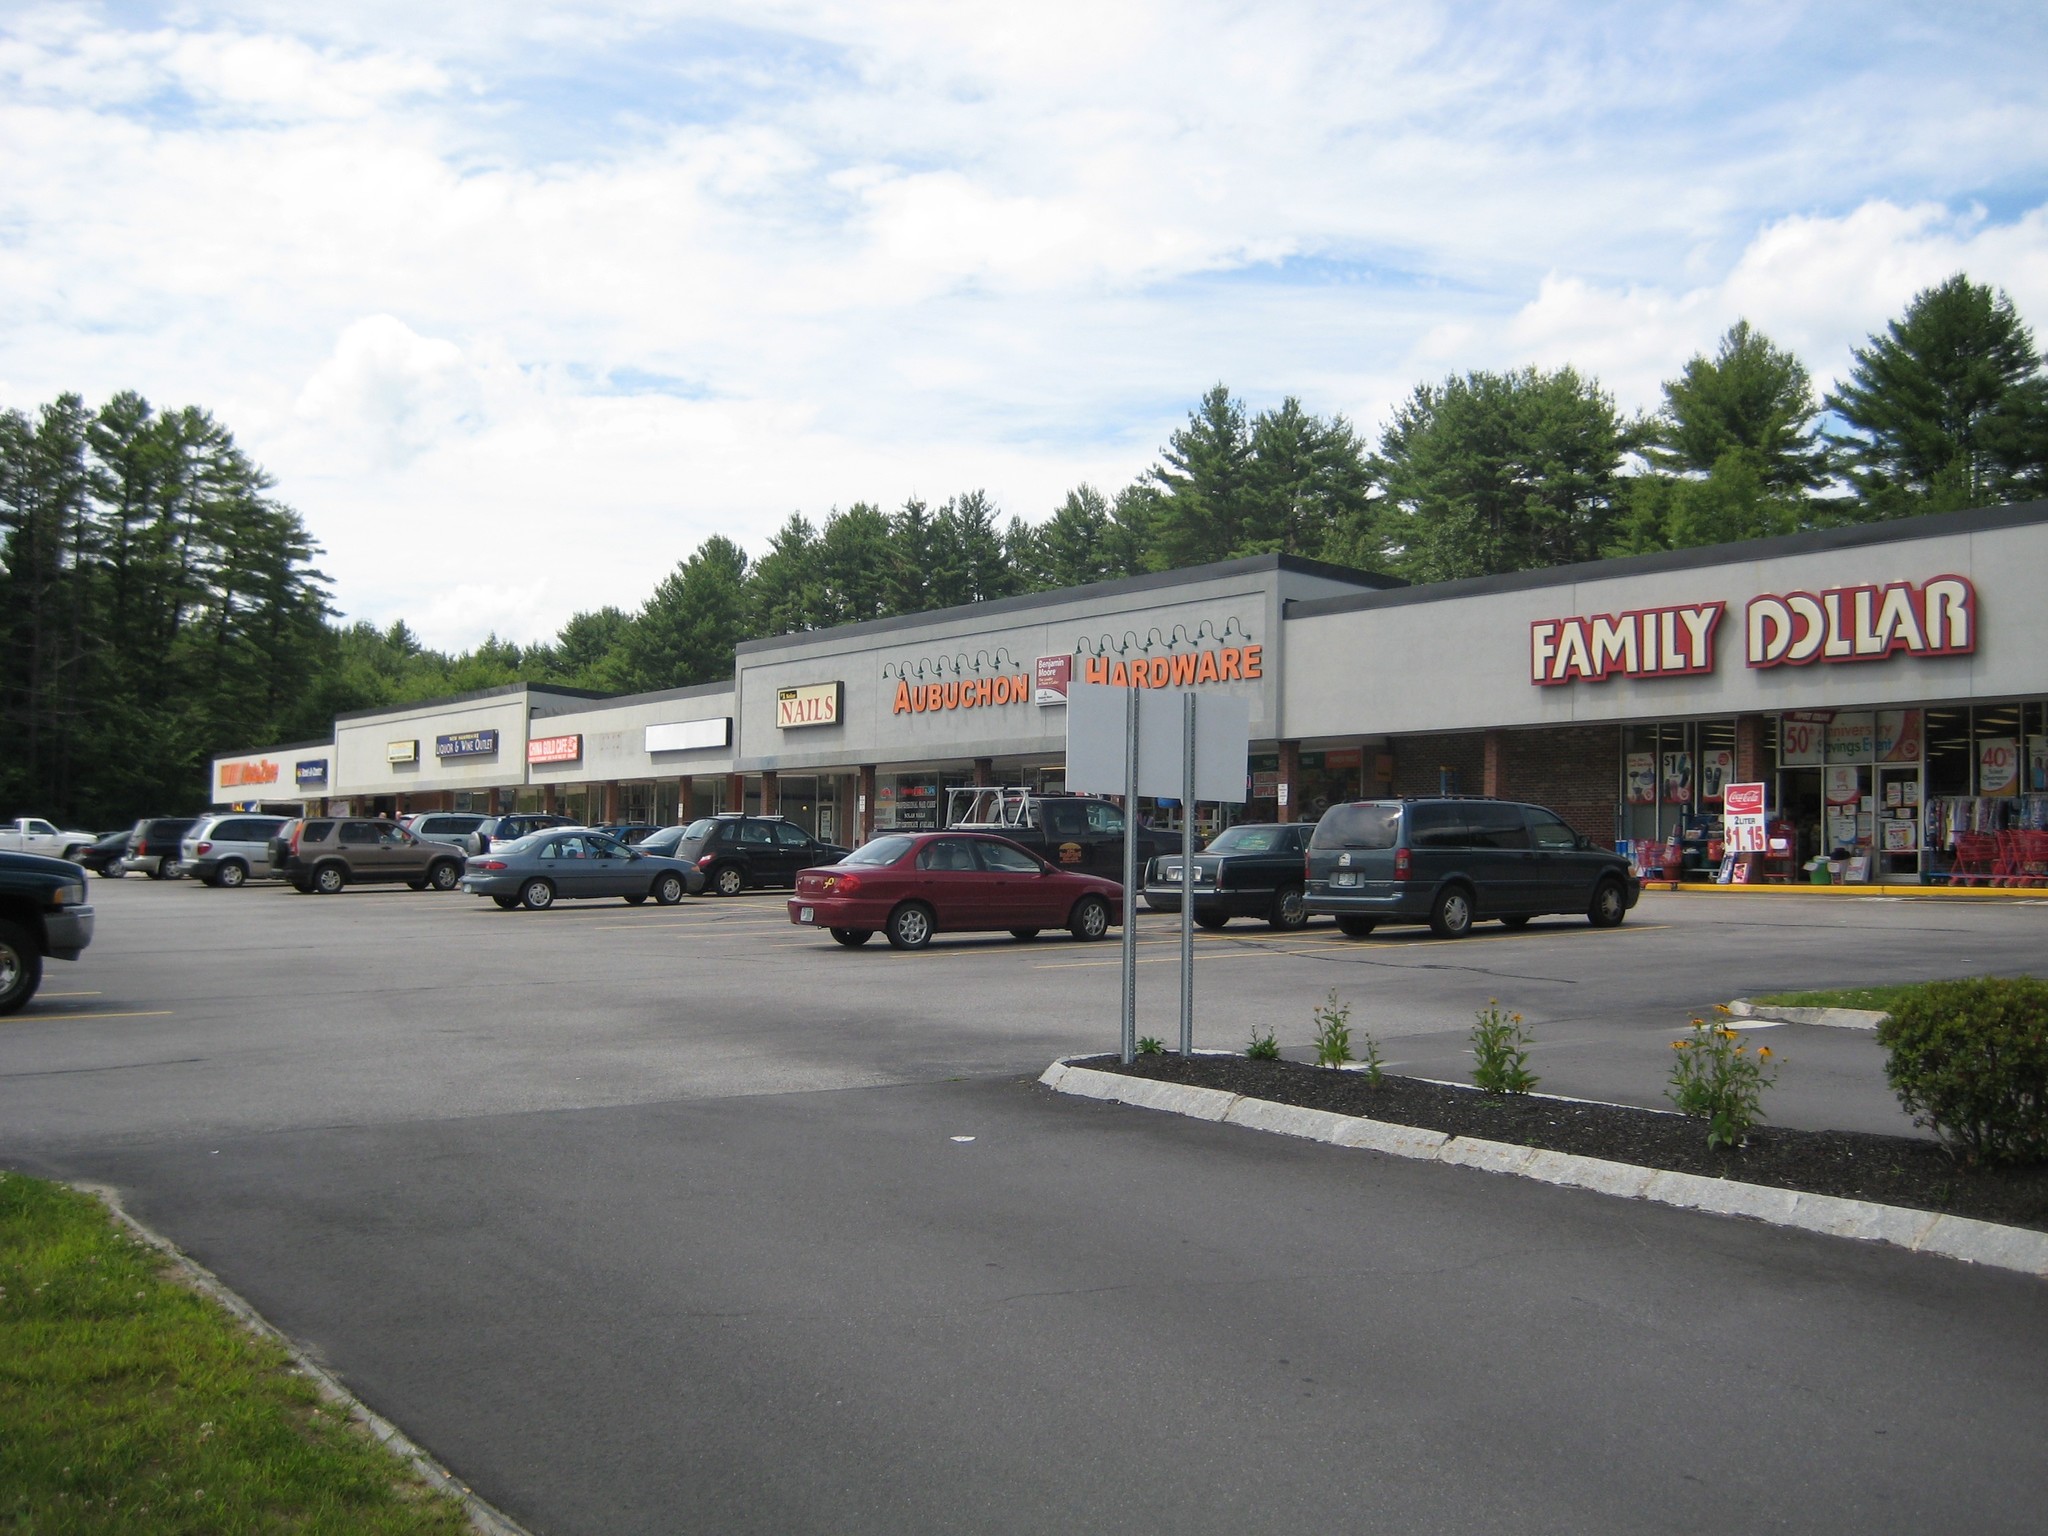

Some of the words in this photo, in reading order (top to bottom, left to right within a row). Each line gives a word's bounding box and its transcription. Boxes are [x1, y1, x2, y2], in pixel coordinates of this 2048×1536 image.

[1531, 603, 1722, 683] FAMILY
[1747, 577, 1970, 665] DOLLAR
[1038, 658, 1065, 669] Benjamin
[892, 673, 1030, 715] AUBUCHON
[1085, 644, 1263, 690] HARDWARE
[1038, 668, 1057, 677] Moore
[780, 695, 833, 724] NAILS
[436, 743, 454, 755] LIQUOR
[460, 740, 474, 752] WINE
[474, 738, 493, 751] OUTLET
[528, 741, 543, 757] CHINA
[1664, 754, 1677, 775] $1
[1728, 790, 1760, 803] Coca-Cola
[1734, 816, 1739, 825] 2
[1739, 817, 1756, 825] LITER
